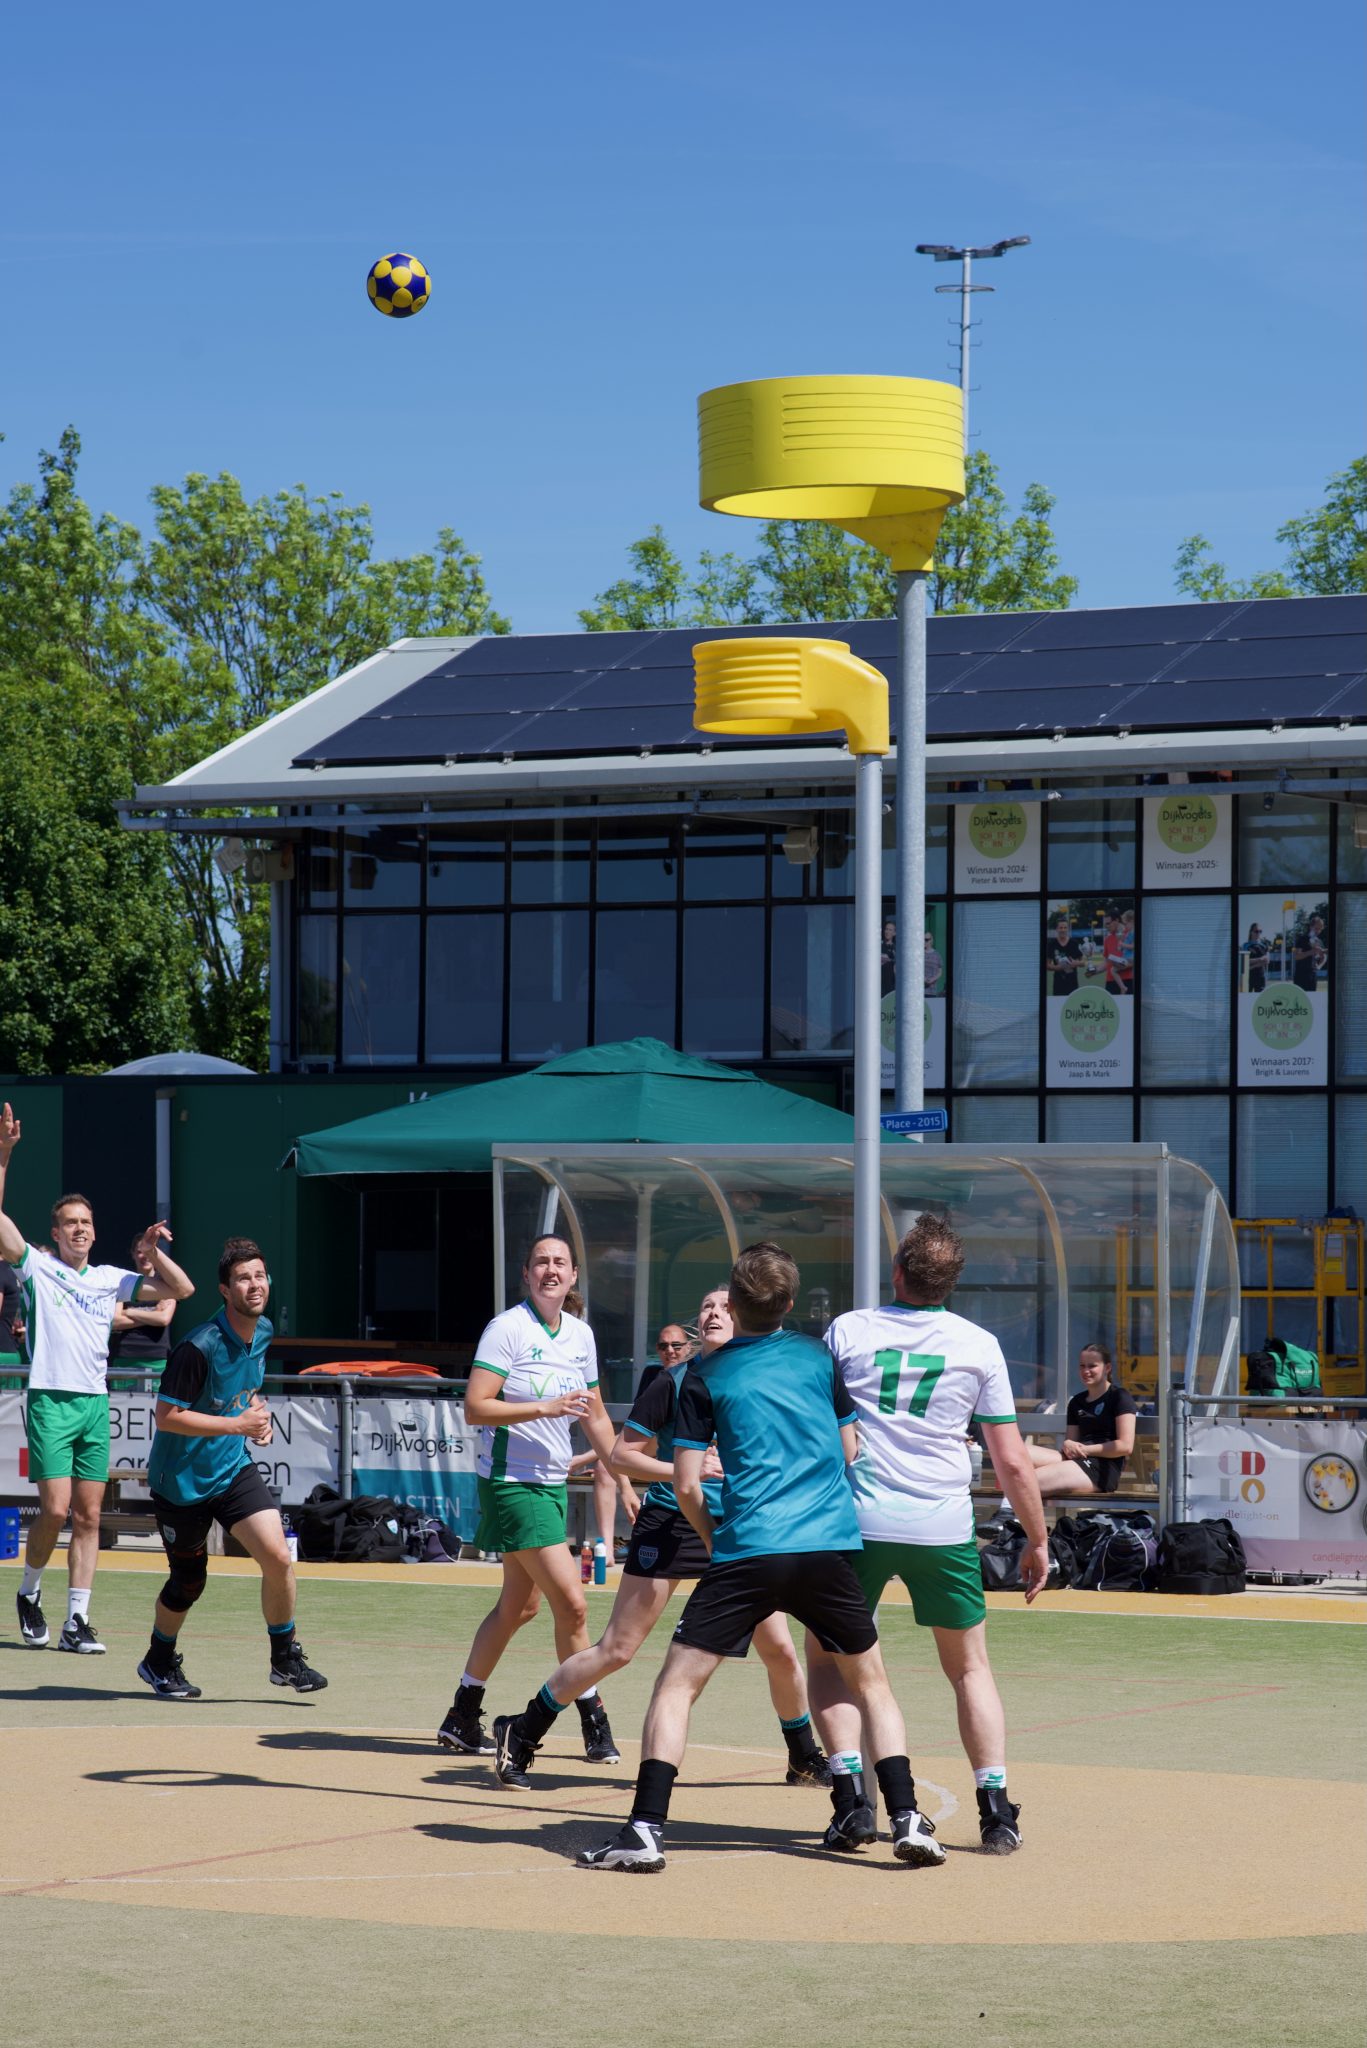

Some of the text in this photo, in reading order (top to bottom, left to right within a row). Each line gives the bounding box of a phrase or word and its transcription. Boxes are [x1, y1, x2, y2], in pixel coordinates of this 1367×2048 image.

[966, 864, 1029, 875] Winnaars 2024:
[1155, 861, 1194, 870] Winnaars
[999, 876, 1024, 884] Wouter
[1059, 1059, 1097, 1068] Winnaars
[1250, 1056, 1315, 1066] Winnaars 2017:
[1092, 1070, 1110, 1078] Mark
[1282, 1068, 1310, 1076] Laurens
[886, 1119, 911, 1129] Place
[917, 1116, 941, 1127] 2015
[873, 1348, 946, 1419] 17
[370, 1432, 464, 1458] Dijkvogels
